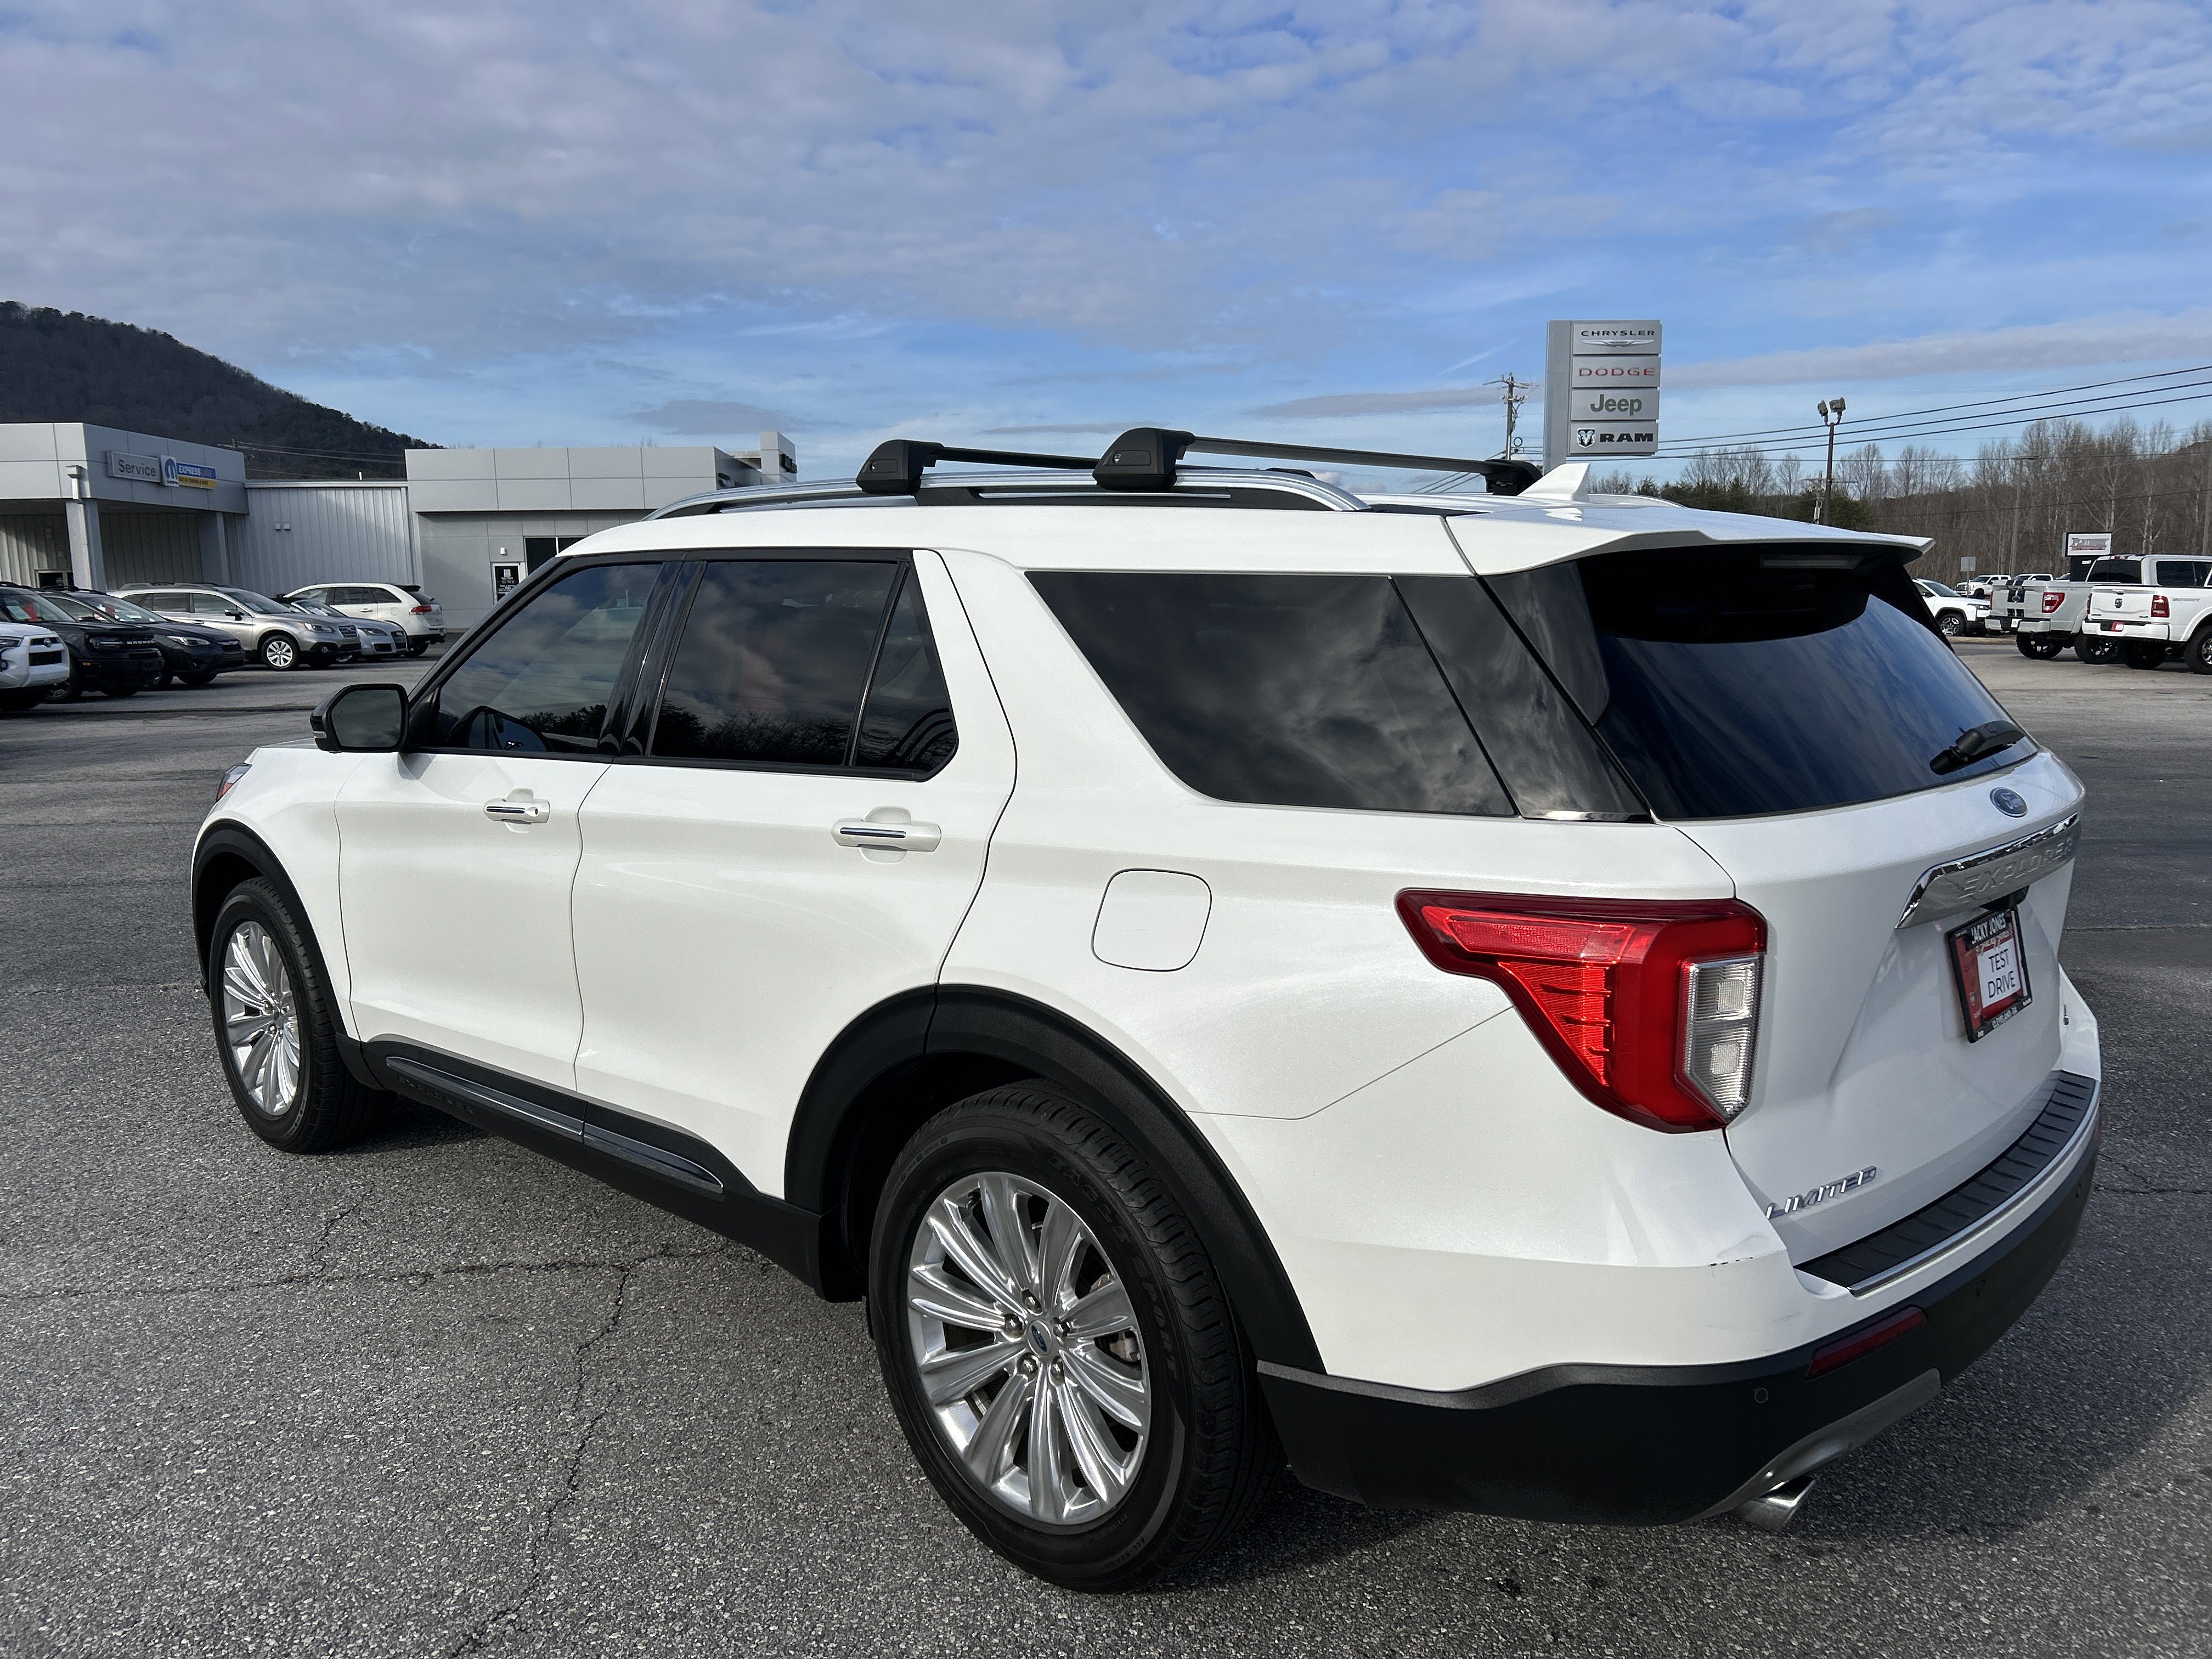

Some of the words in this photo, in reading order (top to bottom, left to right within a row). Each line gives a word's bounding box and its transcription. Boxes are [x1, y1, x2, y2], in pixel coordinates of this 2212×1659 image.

[1579, 367, 1655, 376] DODGE
[1590, 394, 1643, 416] Jeep
[1600, 433, 1654, 443] RAM
[118, 459, 156, 477] Service
[178, 465, 201, 476] EXPRESS
[1957, 836, 2074, 899] EXPLORER
[1971, 921, 1989, 945] JACKY
[1988, 912, 2007, 935] JONES
[1988, 949, 2009, 973] TEST
[1988, 970, 2016, 998] DRIVE
[1765, 1165, 1877, 1220] LIMITED
